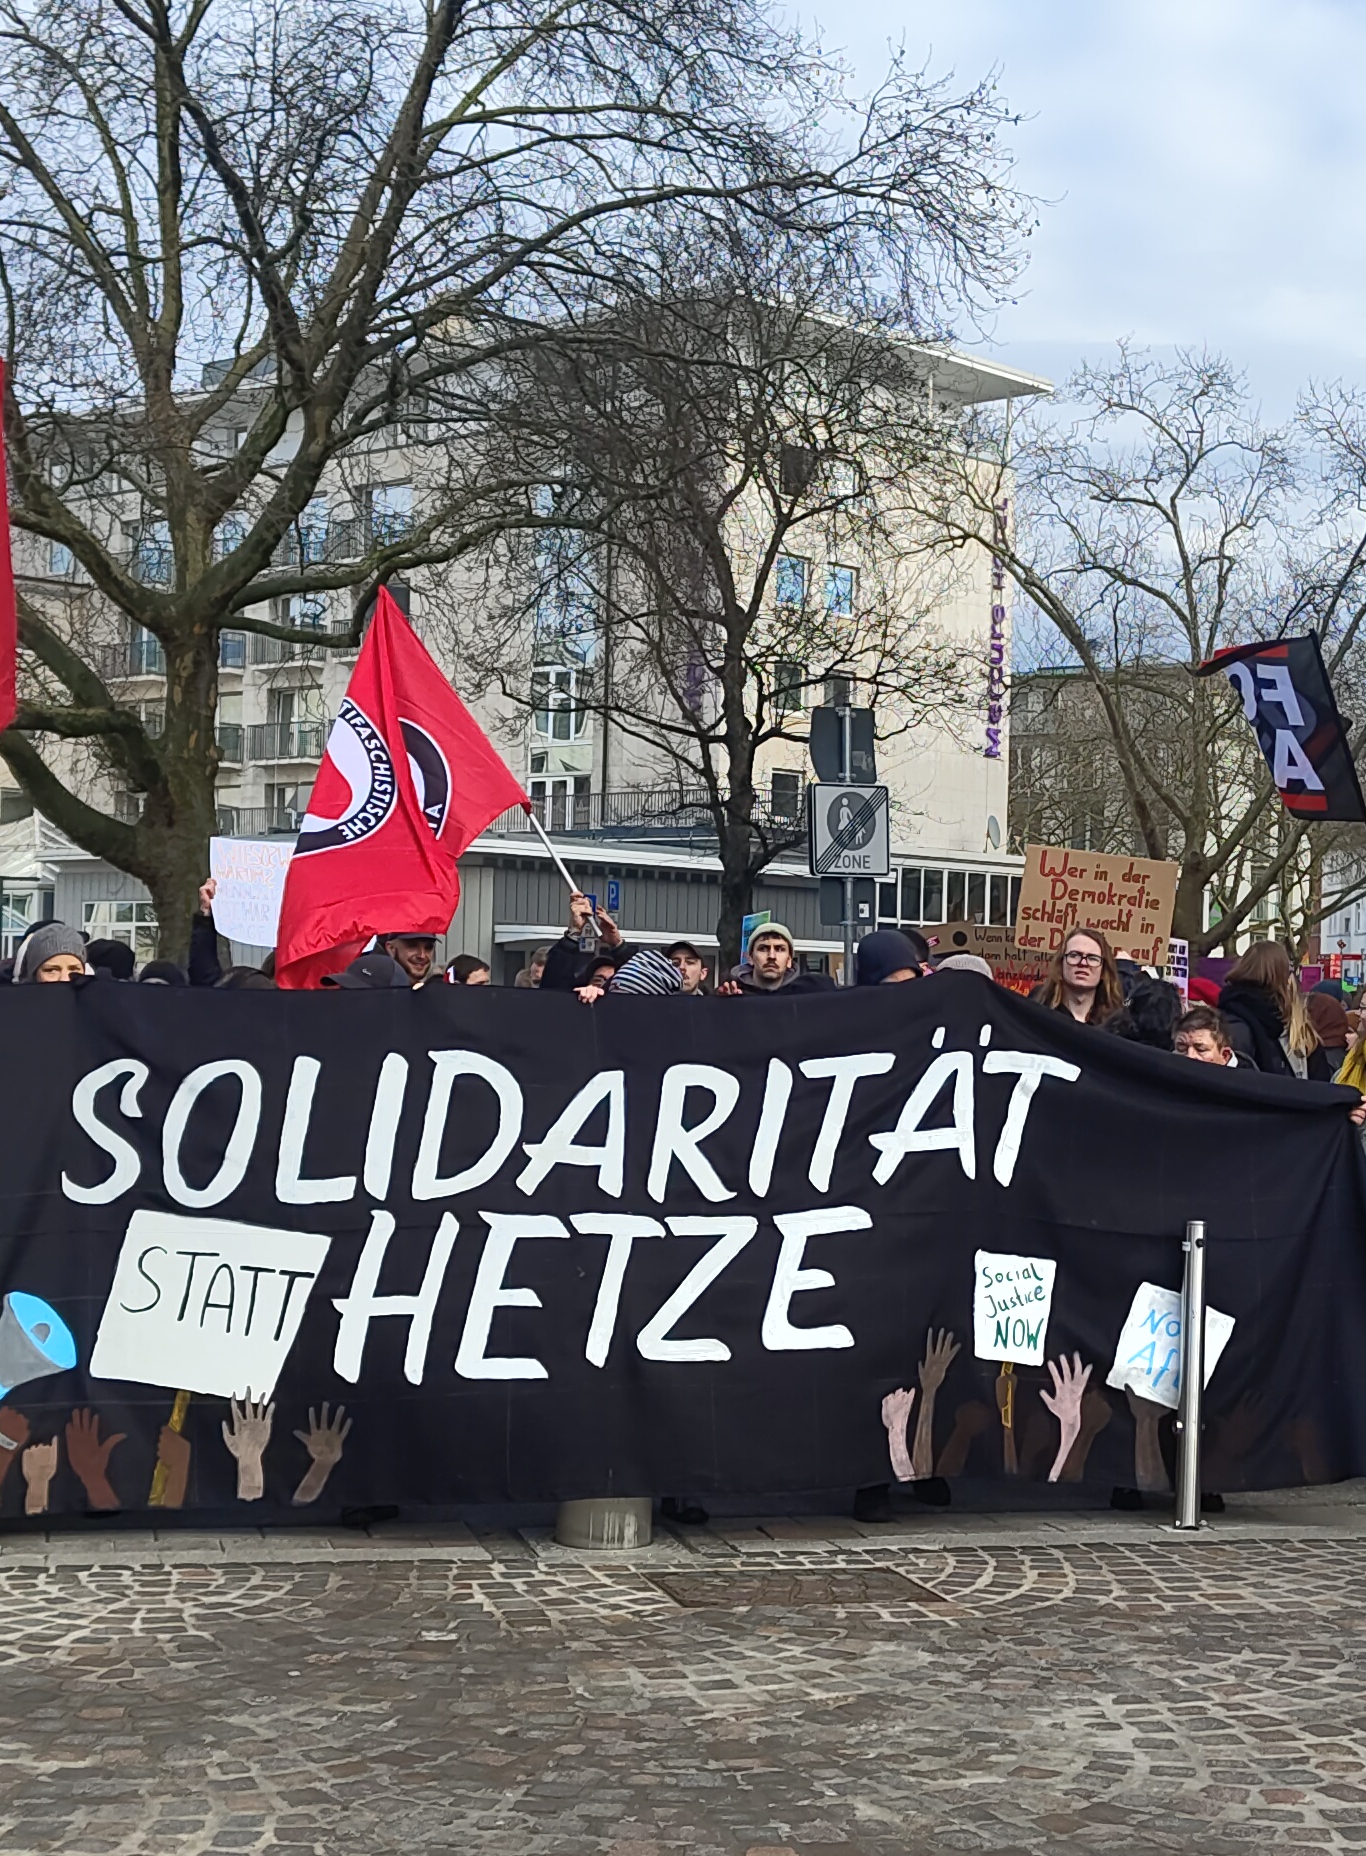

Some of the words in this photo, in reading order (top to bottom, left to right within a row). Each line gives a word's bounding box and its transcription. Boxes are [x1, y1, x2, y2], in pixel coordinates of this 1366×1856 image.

[984, 604, 1006, 758] Mercure
[833, 854, 871, 869] ZONE
[1039, 849, 1087, 878] Wer
[1094, 863, 1108, 882] in
[1122, 862, 1151, 884] der
[1050, 877, 1161, 910] Demokratie
[975, 927, 1002, 943] Wenn
[1086, 908, 1133, 932] wacht
[1140, 917, 1155, 934] in
[1018, 924, 1046, 948] der
[1131, 937, 1163, 965] auf
[61, 1026, 1081, 1209] SOLIDARITÄT
[983, 1262, 1044, 1288] Social
[120, 1243, 315, 1345] STATT
[332, 1206, 873, 1386] HETZE
[984, 1285, 1046, 1318] Justice
[993, 1316, 1044, 1351] NOW
[1127, 1340, 1180, 1388] Af
